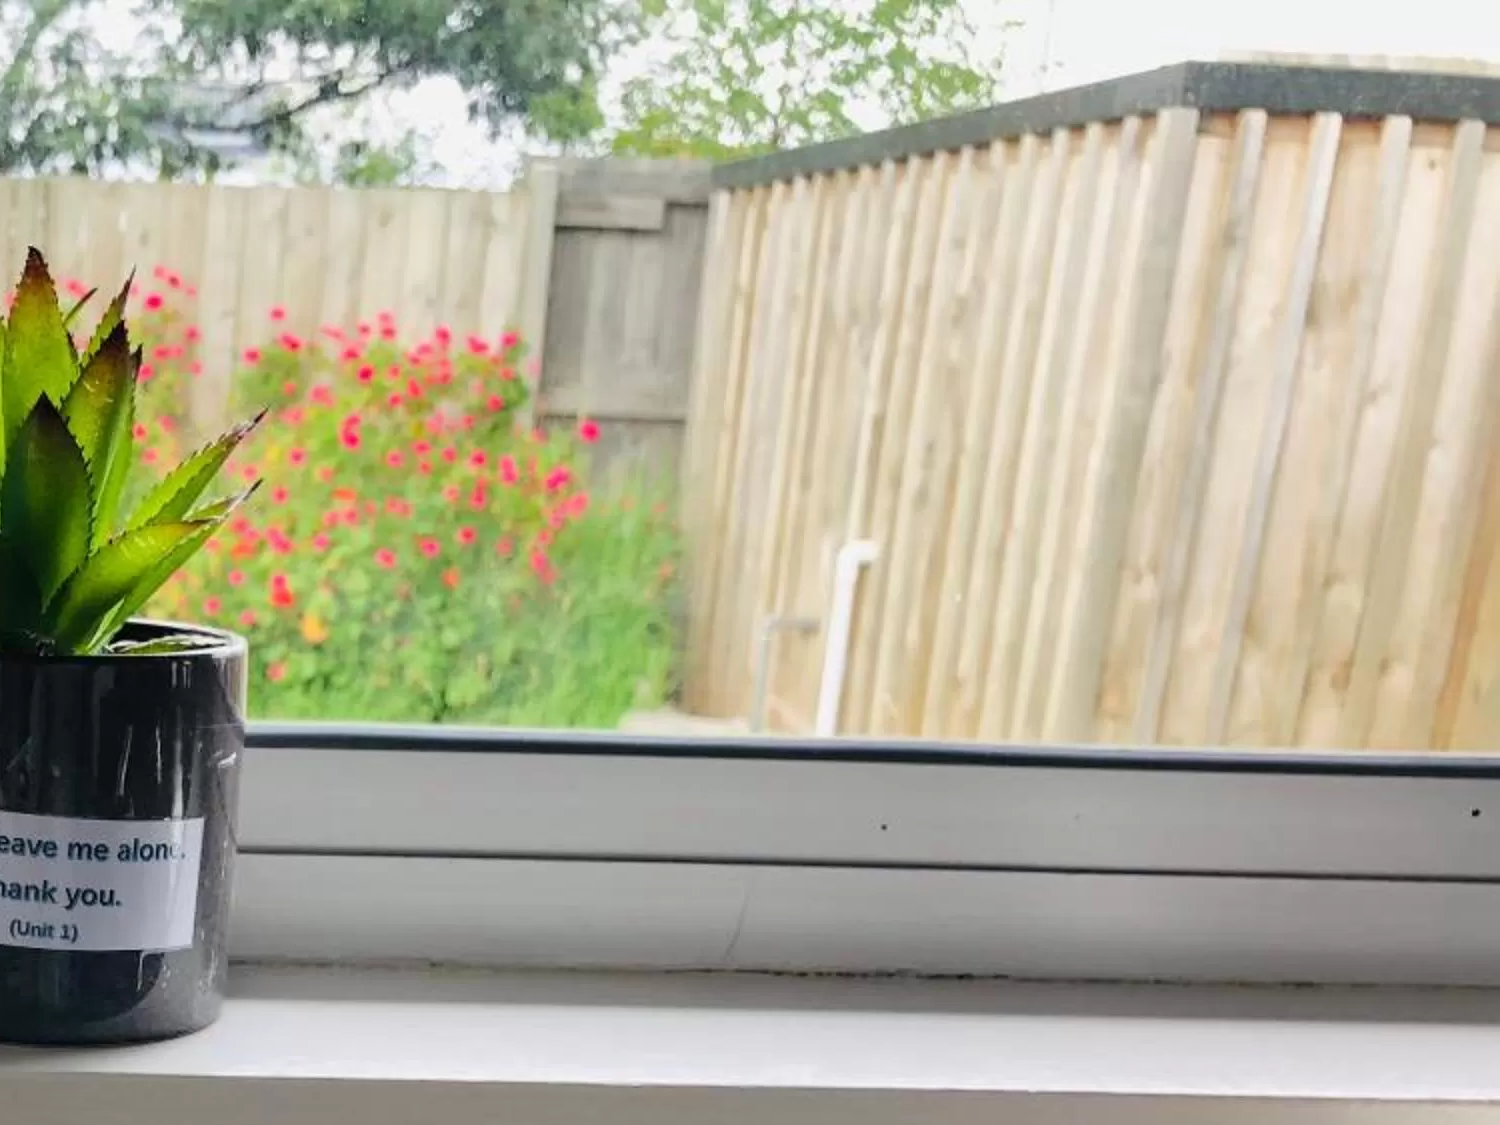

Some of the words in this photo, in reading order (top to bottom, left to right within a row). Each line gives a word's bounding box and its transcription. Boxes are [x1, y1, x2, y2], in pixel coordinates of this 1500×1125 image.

[67, 839, 112, 863] me
[64, 885, 121, 911] you.
[8, 918, 55, 939] (Unit
[58, 923, 79, 943] 1)
